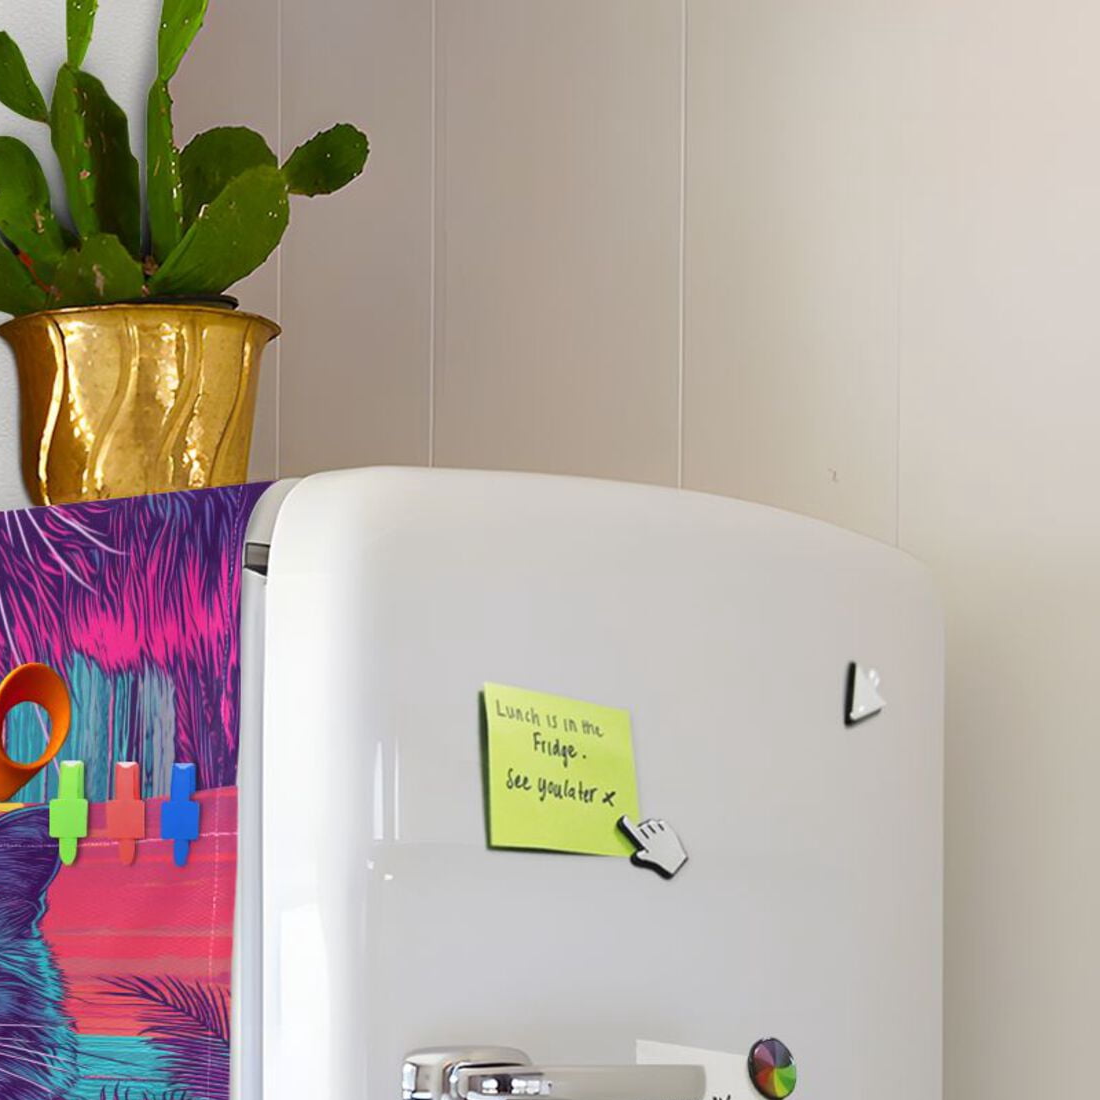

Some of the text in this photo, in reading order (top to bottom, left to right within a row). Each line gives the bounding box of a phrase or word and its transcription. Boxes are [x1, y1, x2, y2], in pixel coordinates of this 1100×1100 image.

[495, 698, 540, 727] Lunch
[563, 717, 578, 733] in
[582, 719, 604, 738] the
[506, 767, 532, 791] See
